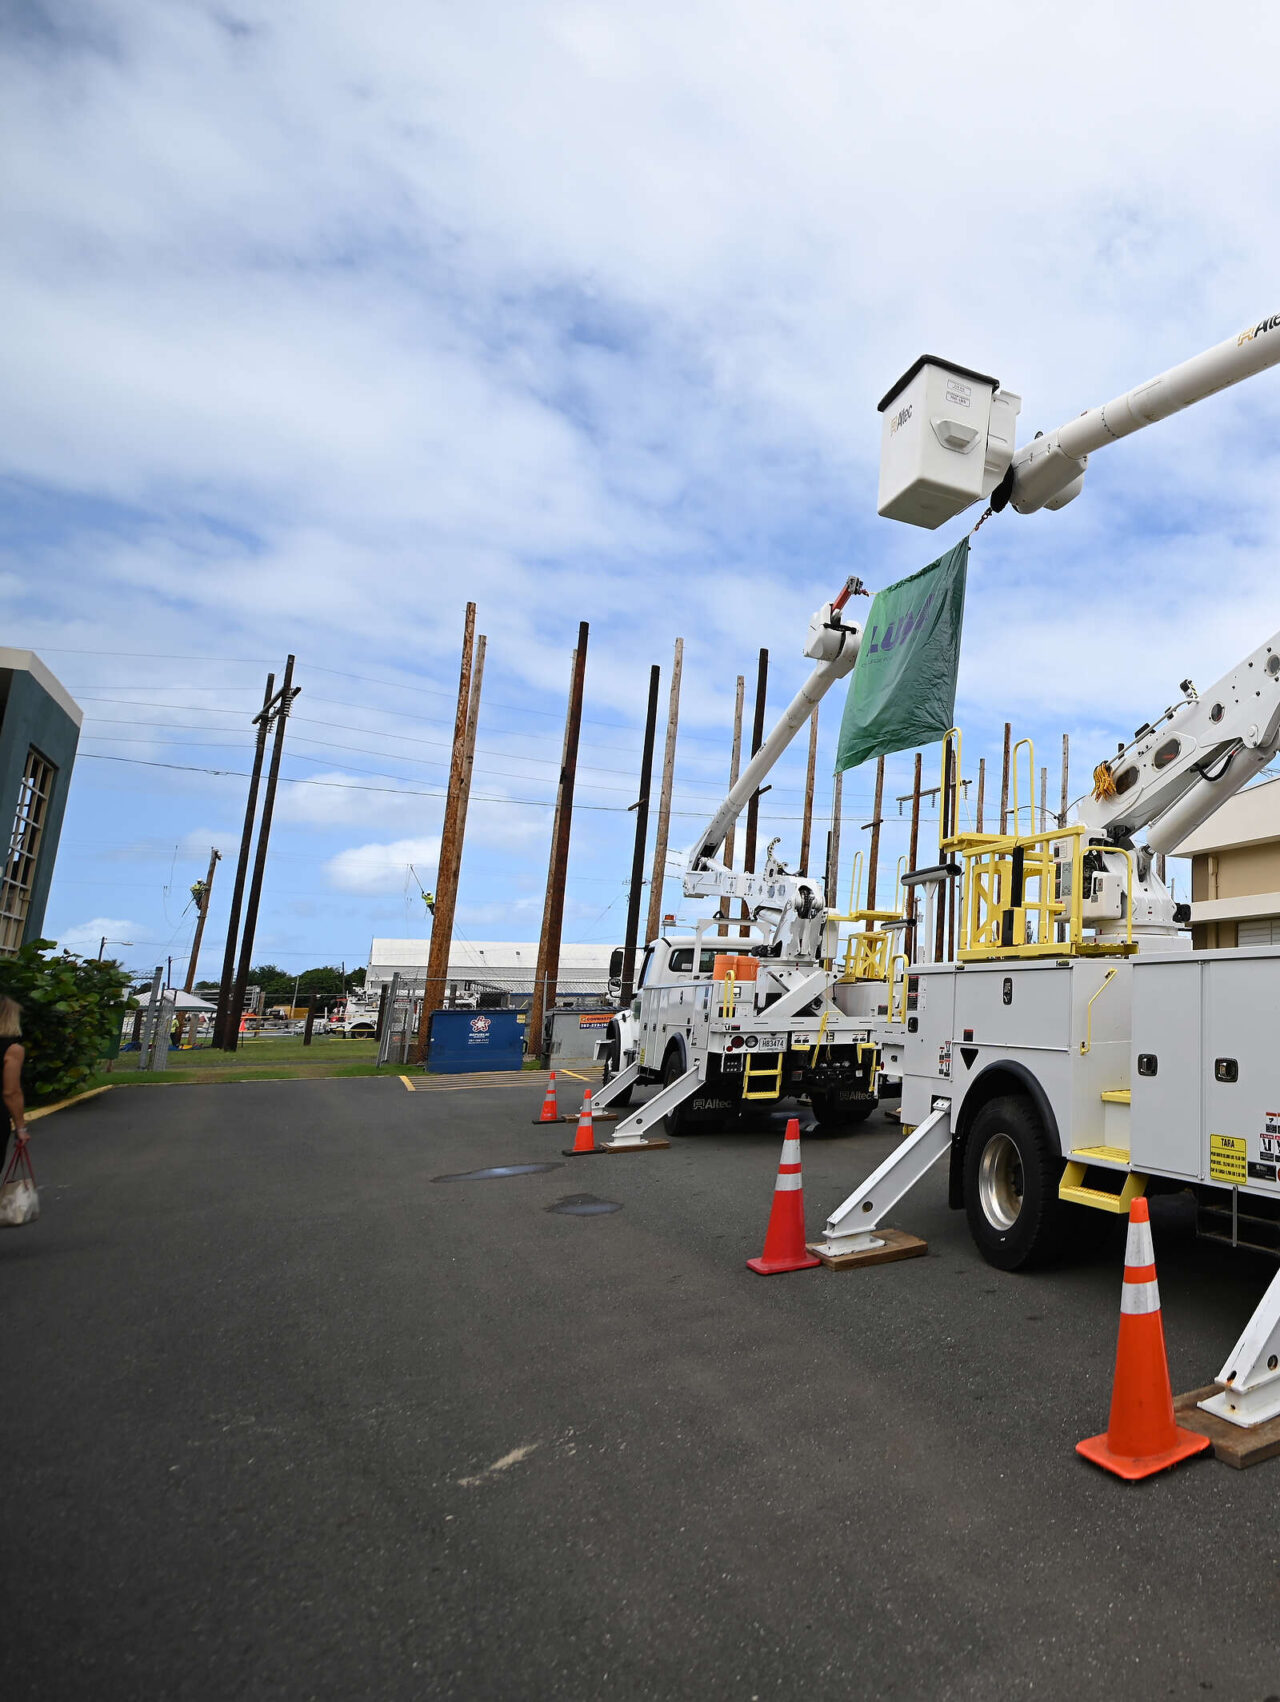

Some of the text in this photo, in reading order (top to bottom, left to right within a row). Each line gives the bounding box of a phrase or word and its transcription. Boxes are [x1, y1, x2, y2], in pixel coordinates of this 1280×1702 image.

[849, 1092, 872, 1100] Altec
[705, 1099, 731, 1109] Altec
[1221, 1138, 1235, 1148] TARA
